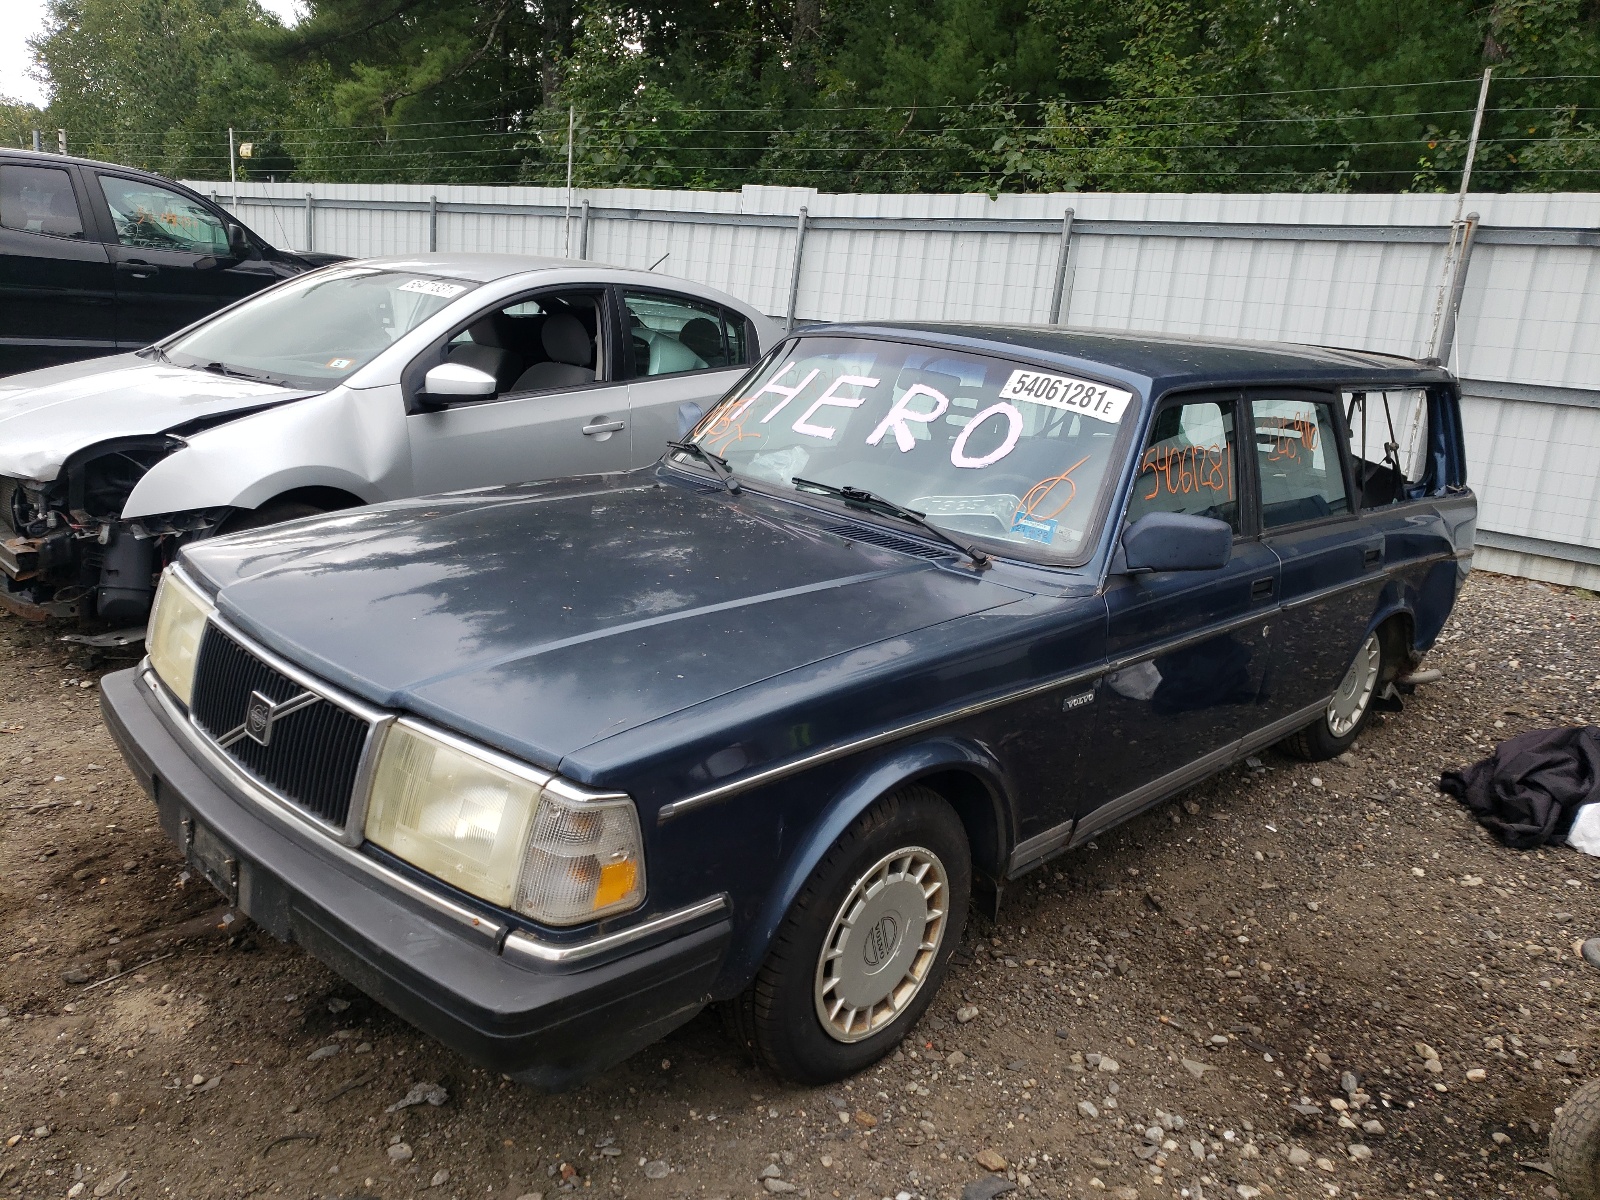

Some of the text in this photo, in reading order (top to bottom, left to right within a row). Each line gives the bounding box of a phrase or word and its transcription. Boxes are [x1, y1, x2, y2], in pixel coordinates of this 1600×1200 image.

[1012, 373, 1108, 412] 54061281
[731, 361, 1024, 469] HERO
[1142, 442, 1232, 501] 54061281
[1066, 693, 1094, 708] VOLVO
[874, 921, 885, 960] VOLVO
